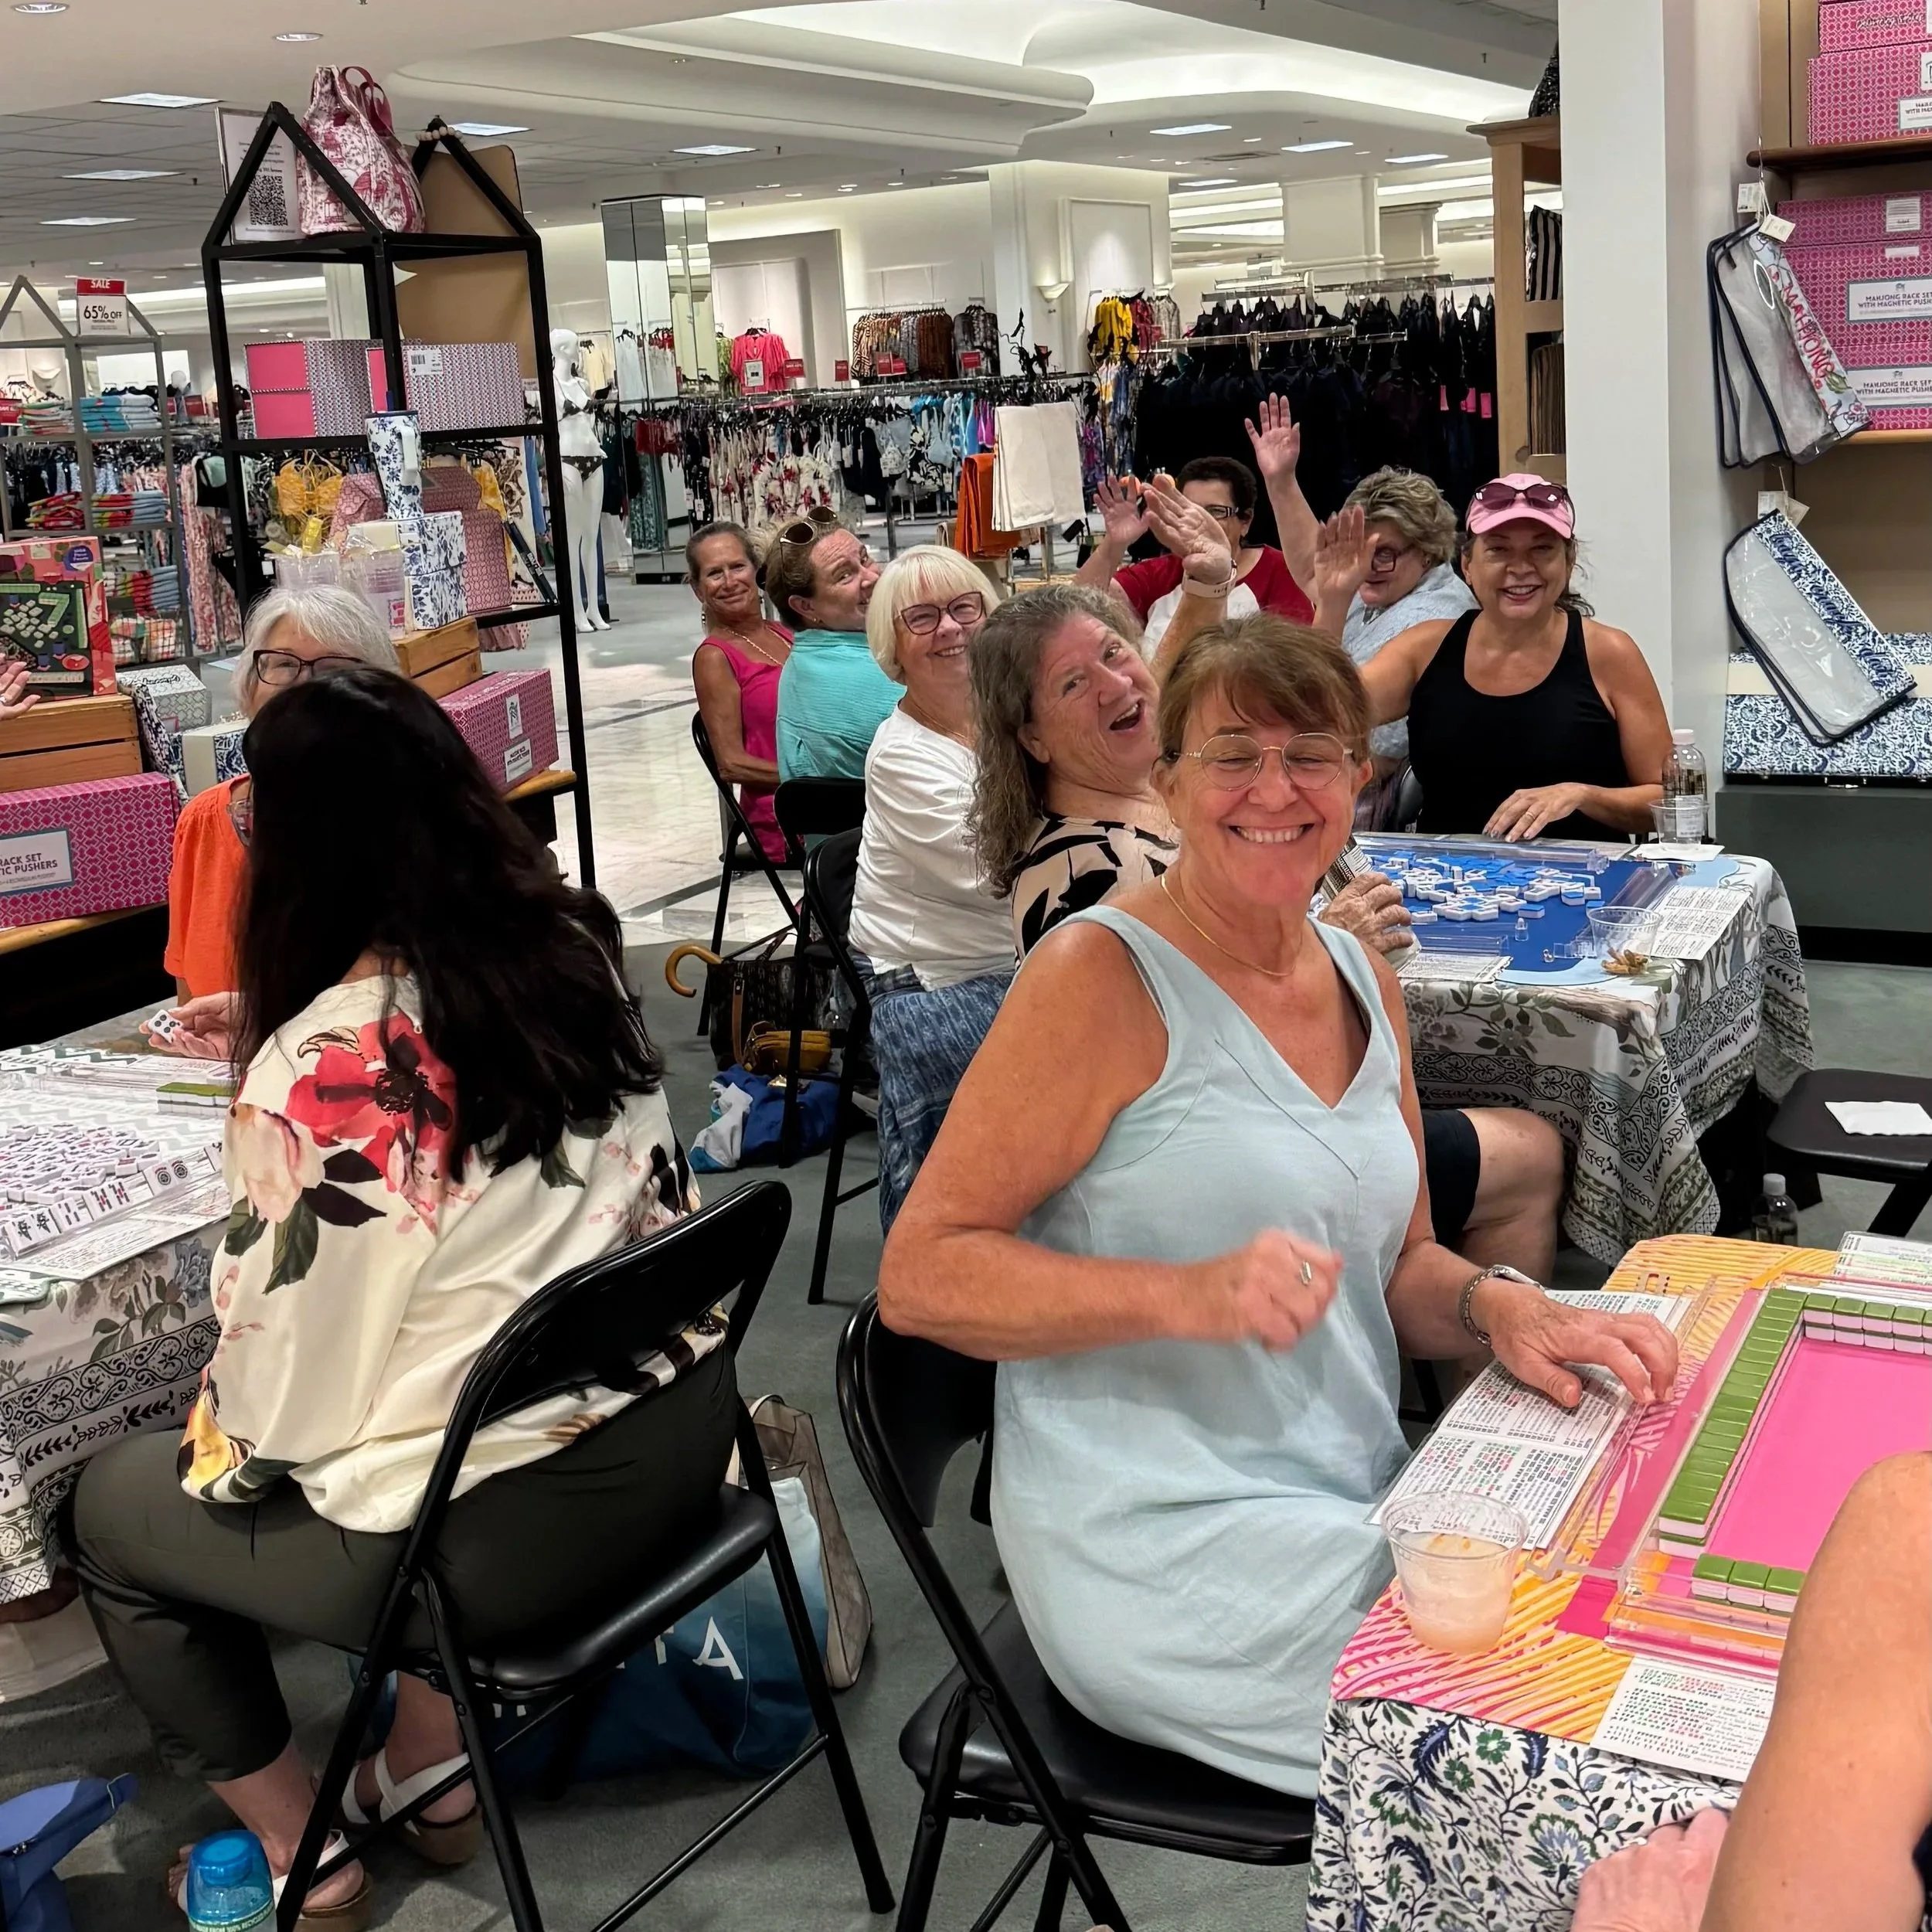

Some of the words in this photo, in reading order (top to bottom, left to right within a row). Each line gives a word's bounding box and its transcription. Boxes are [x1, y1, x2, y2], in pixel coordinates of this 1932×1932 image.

[90, 279, 111, 289] SALE
[83, 305, 109, 319] 65%
[25, 852, 42, 862] SET
[15, 859, 58, 874] PUSHERS
